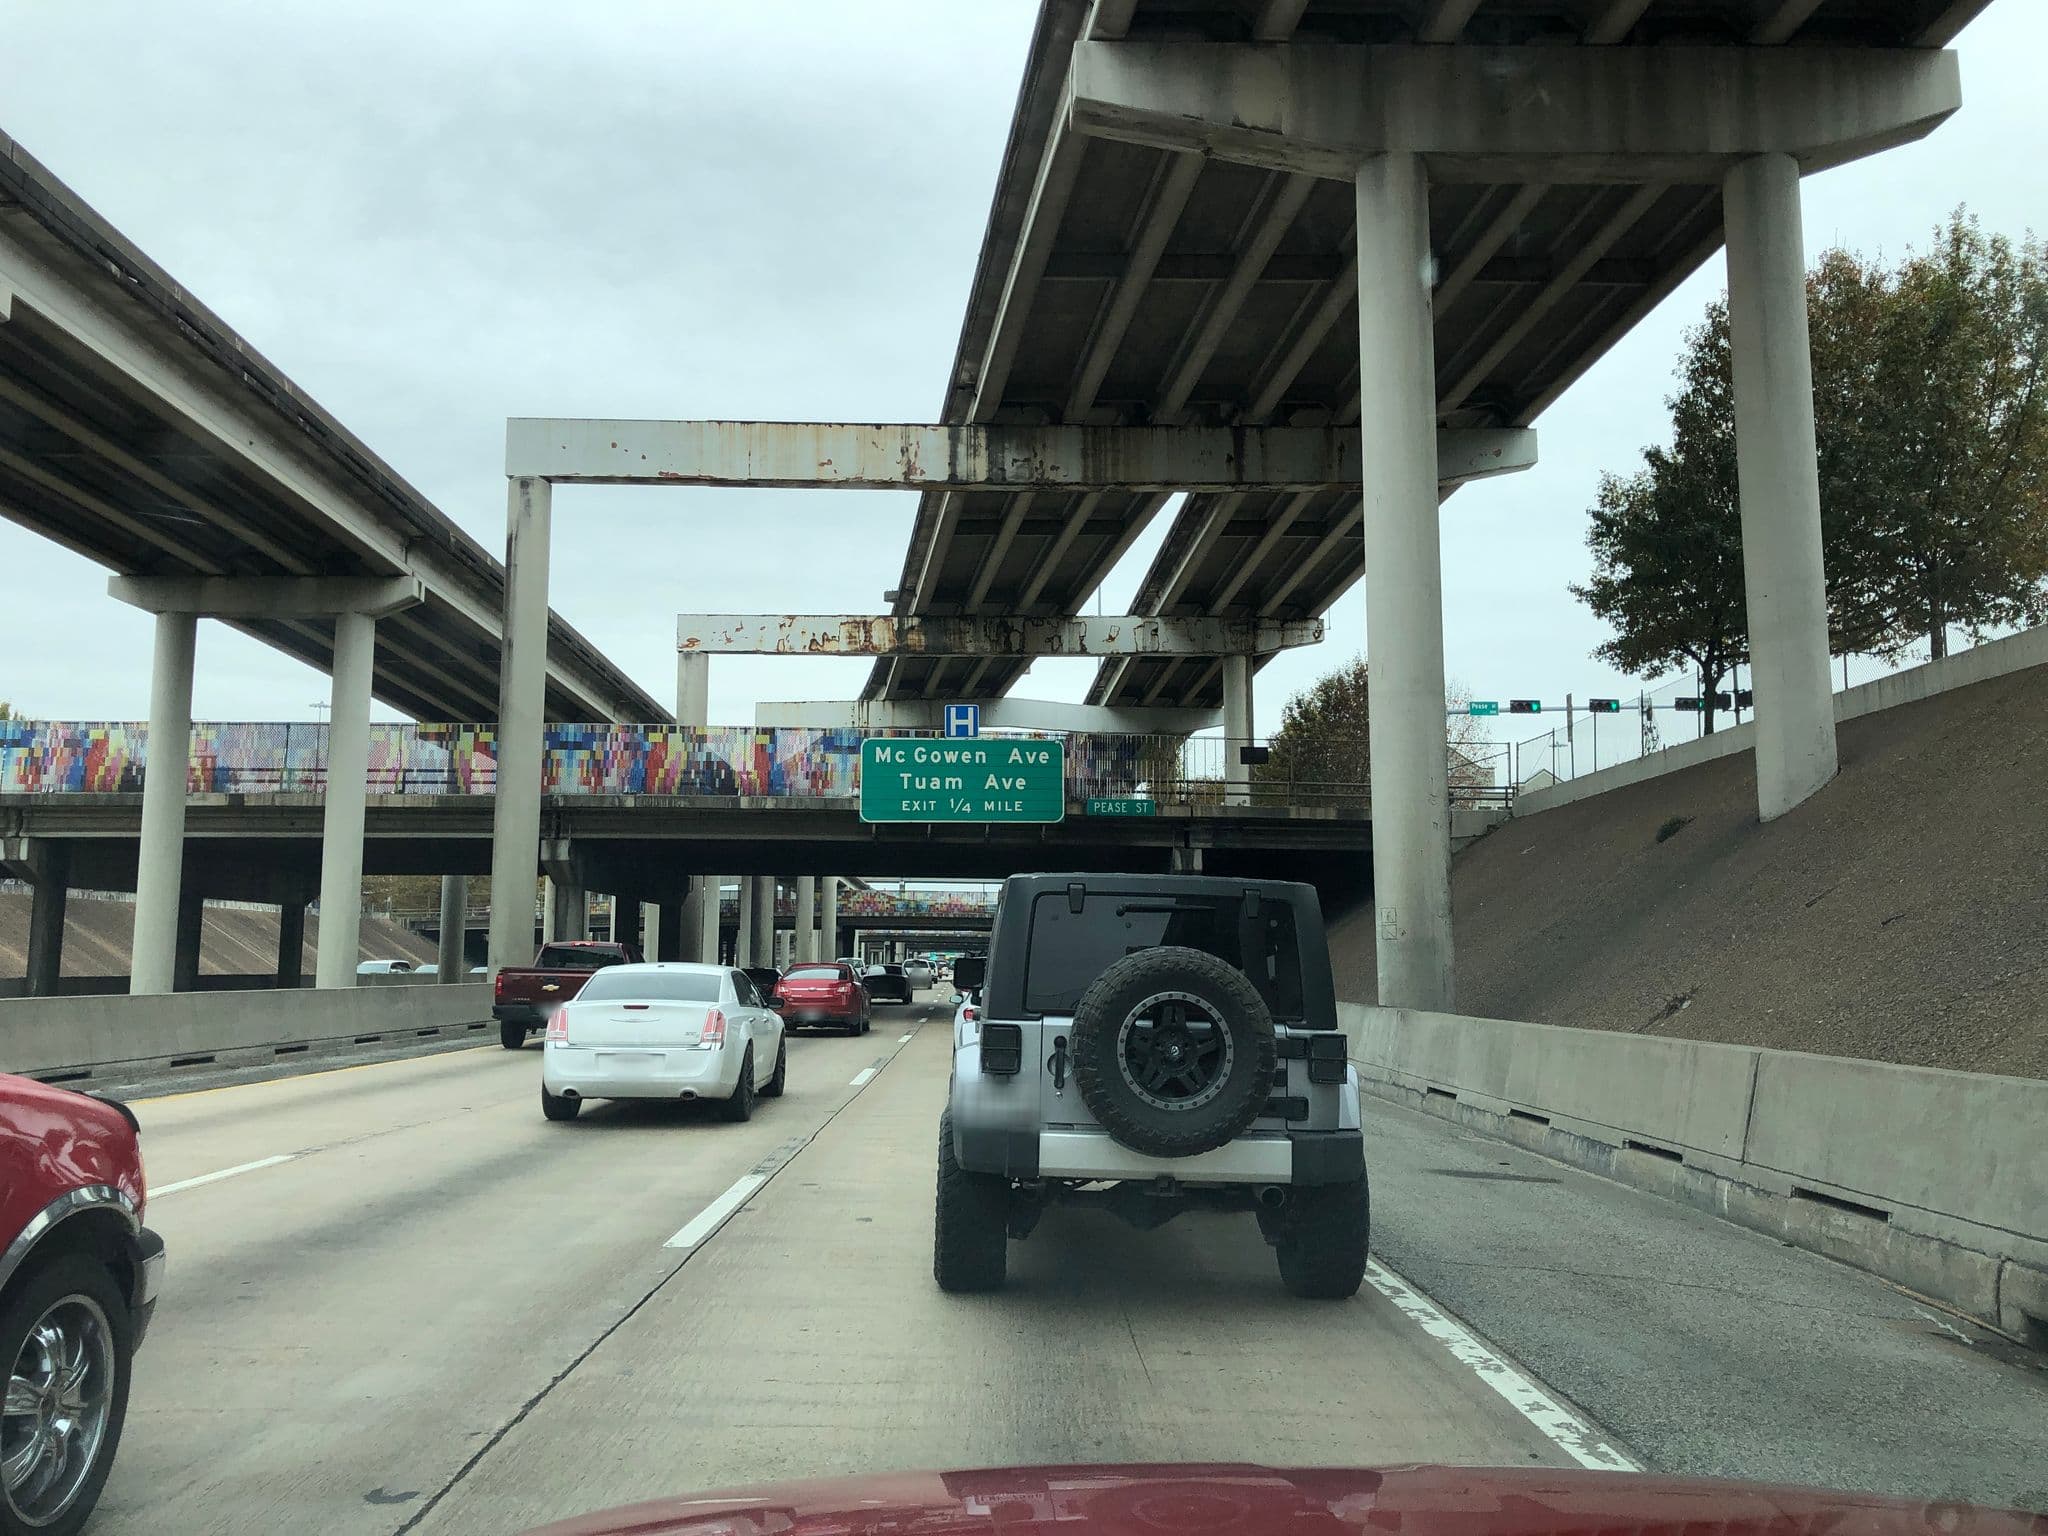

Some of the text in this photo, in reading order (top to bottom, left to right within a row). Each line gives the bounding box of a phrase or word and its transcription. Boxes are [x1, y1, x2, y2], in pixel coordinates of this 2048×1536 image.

[951, 707, 974, 737] H
[1008, 748, 1050, 764] Ave
[900, 773, 1027, 790] Tuam Ave
[902, 801, 937, 812] EXIT
[984, 801, 1023, 812] MILE
[1094, 802, 1148, 813] PEASE ST
